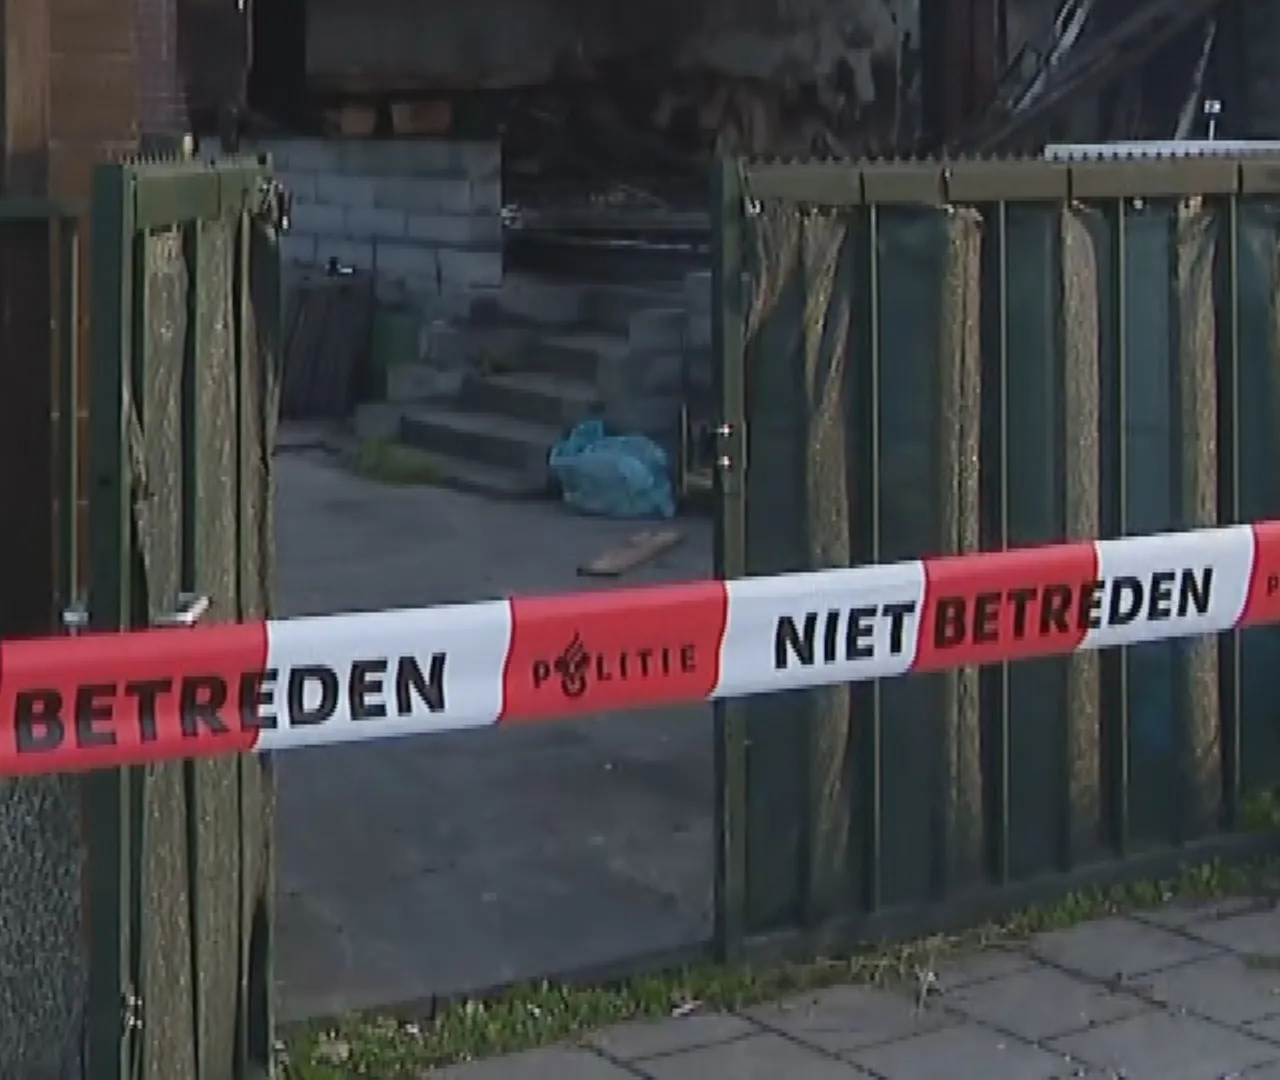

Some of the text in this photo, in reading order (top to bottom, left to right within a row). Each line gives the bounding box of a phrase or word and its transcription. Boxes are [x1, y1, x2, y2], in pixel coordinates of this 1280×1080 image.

[14, 652, 447, 753] BETREDEN
[774, 600, 915, 670] NIET
[933, 567, 1213, 649] BETREDEN
